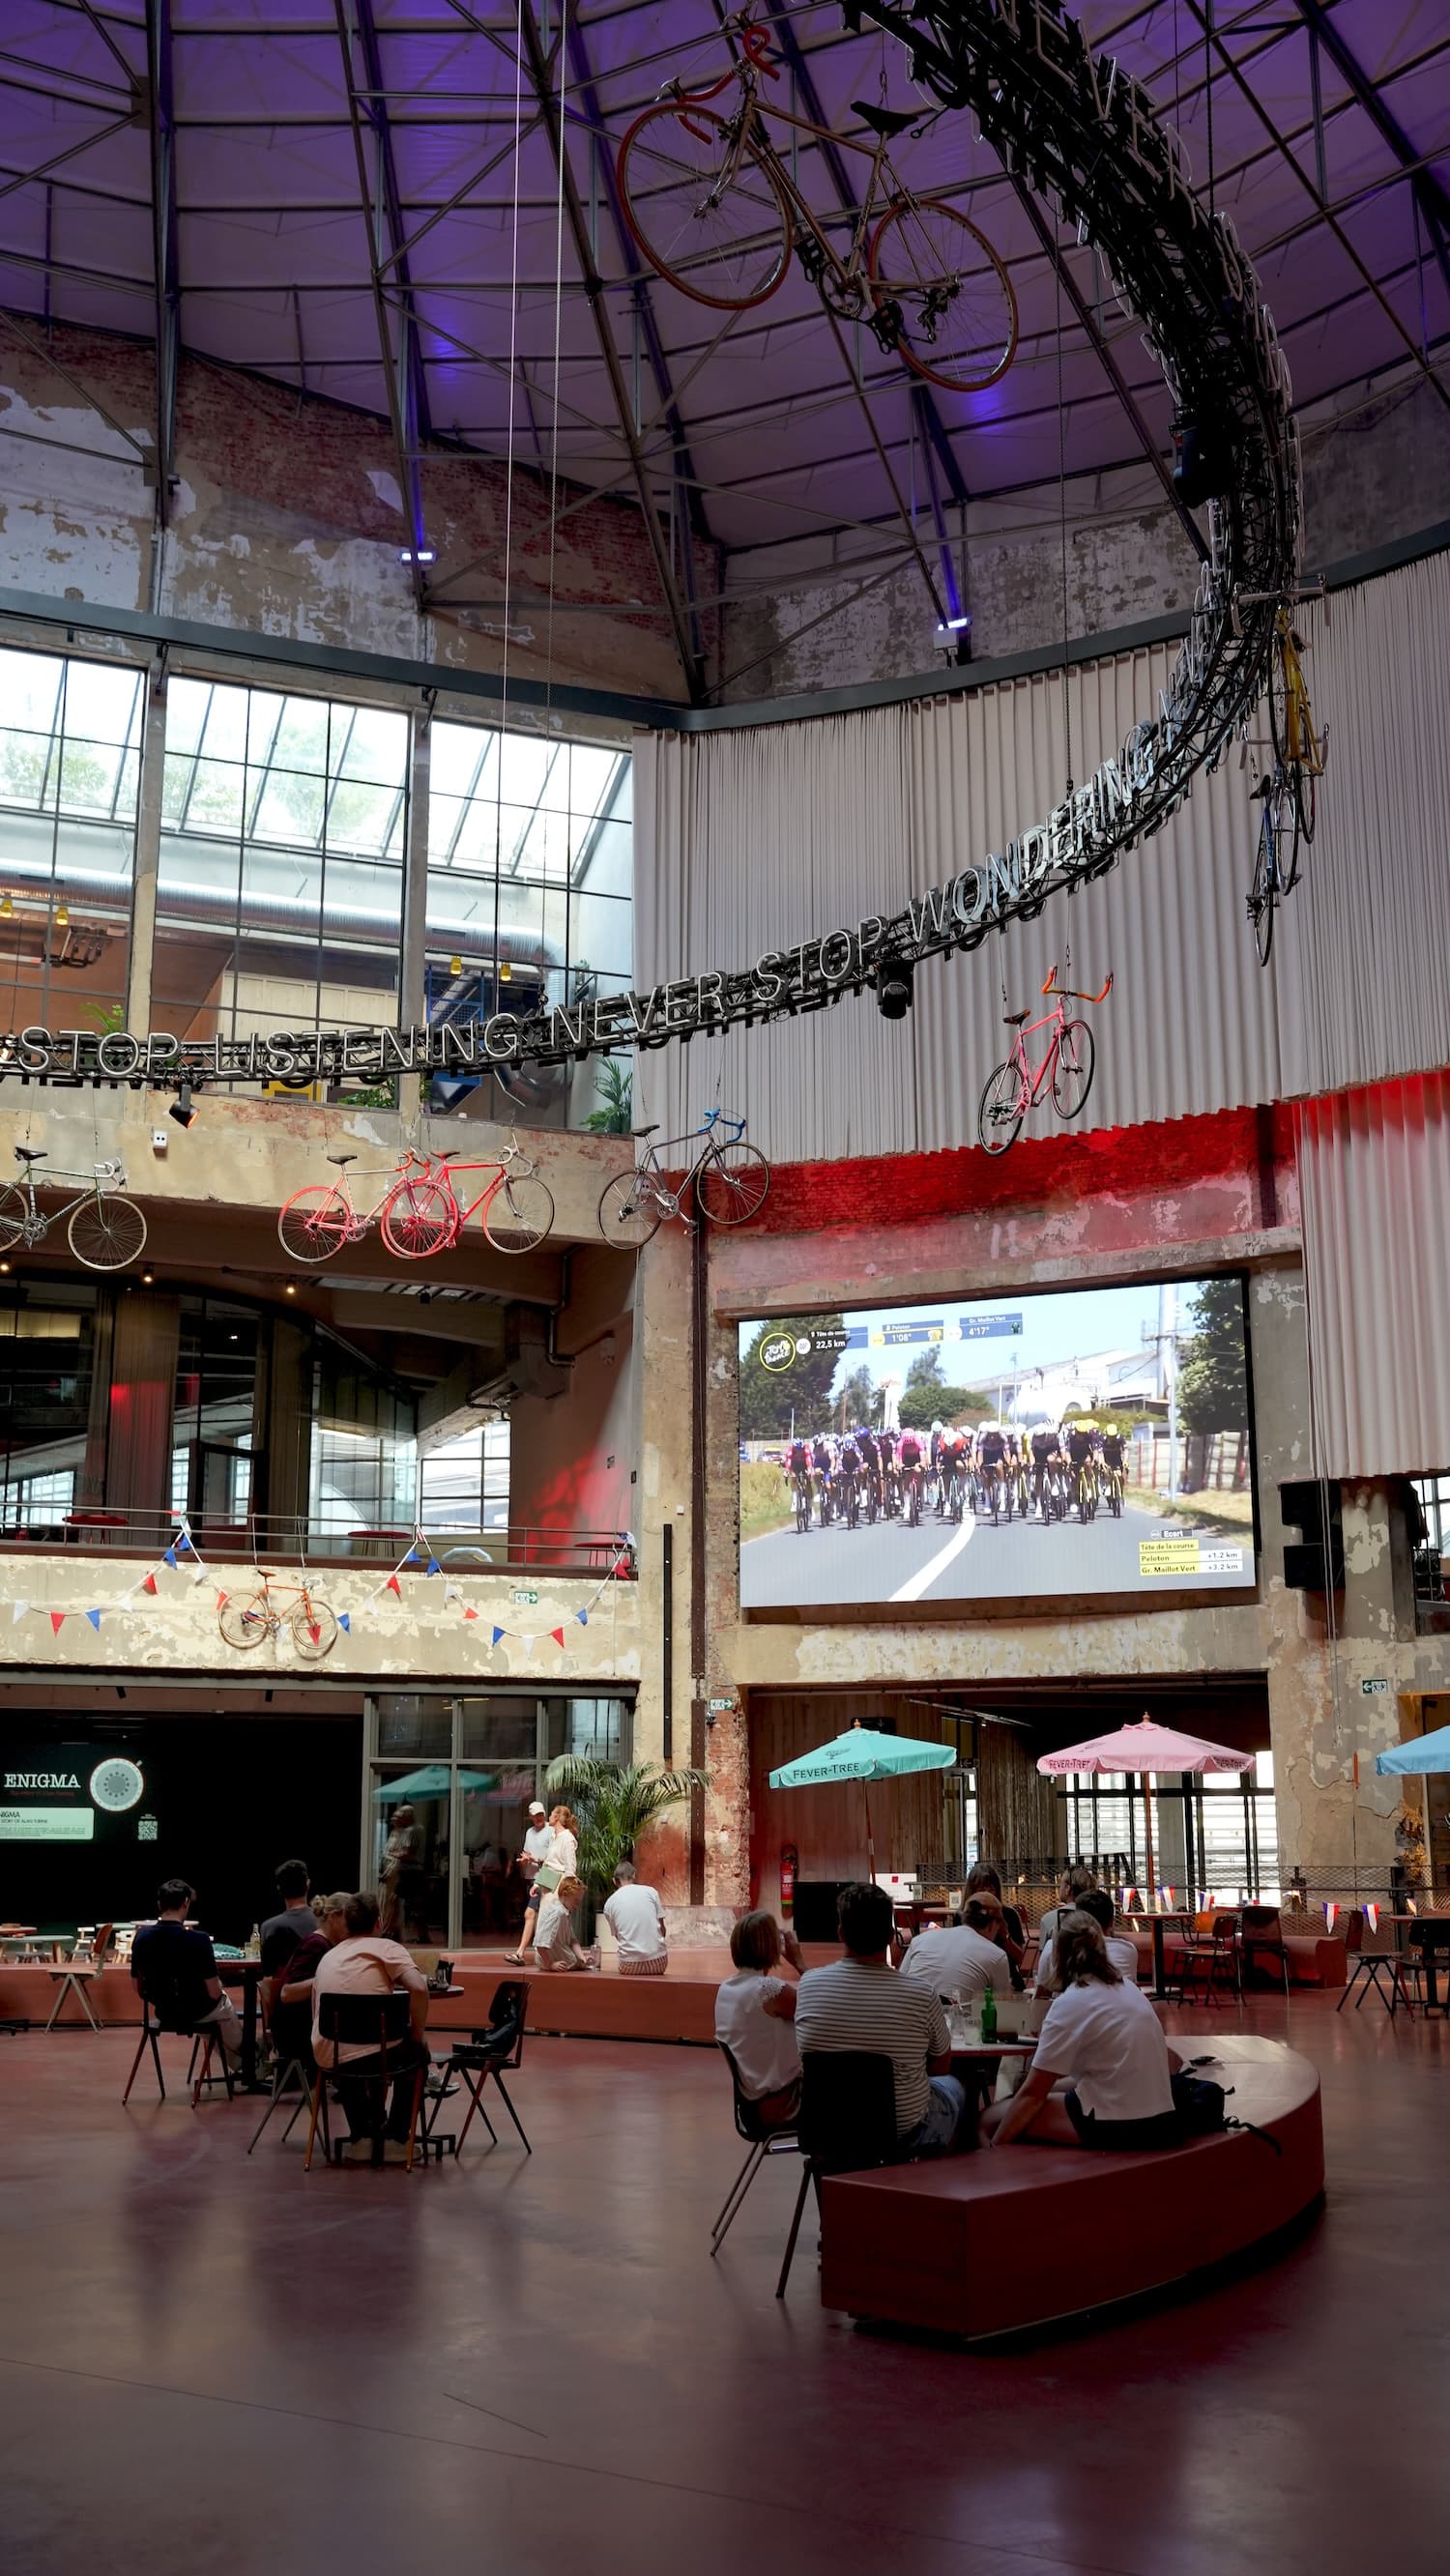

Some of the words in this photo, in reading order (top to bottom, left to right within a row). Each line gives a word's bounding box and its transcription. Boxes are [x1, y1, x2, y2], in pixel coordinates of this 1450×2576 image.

[17, 1026, 181, 1077] STOP
[215, 1011, 523, 1077] LISTENING
[551, 970, 729, 1047] NEVER
[750, 915, 889, 1003] STOP
[909, 720, 1156, 945] WONDERING
[816, 1340, 832, 1349] 22,5
[793, 1761, 860, 1780] FEVER-TREE
[3, 1773, 81, 1789] ENIGMA
